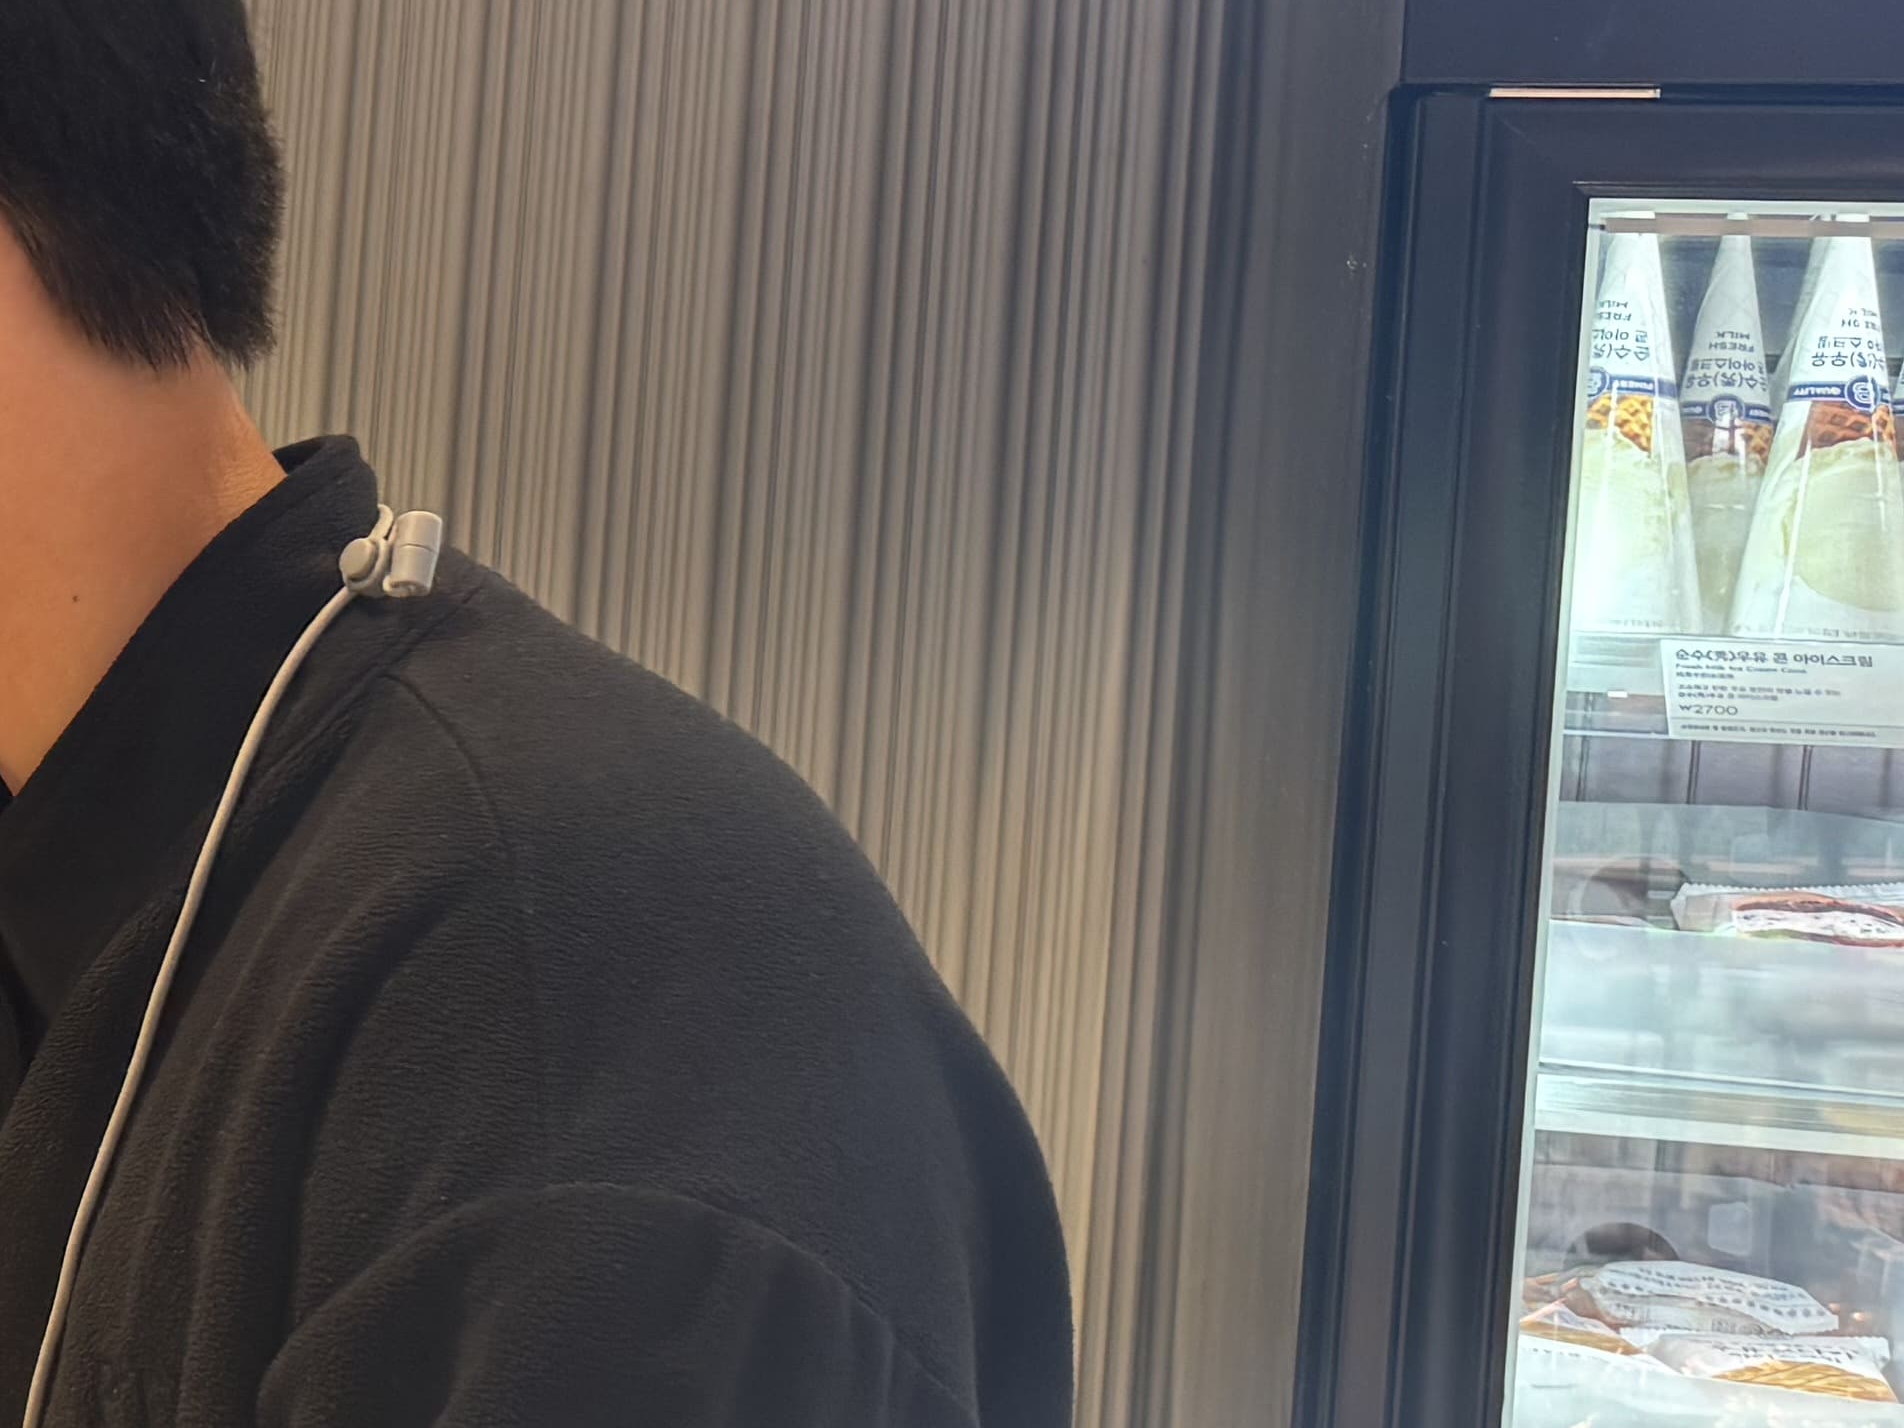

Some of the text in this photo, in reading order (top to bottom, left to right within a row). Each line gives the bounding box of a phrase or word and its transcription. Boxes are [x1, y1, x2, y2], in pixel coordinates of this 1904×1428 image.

[1716, 331, 1750, 341] MILK
[1708, 341, 1755, 354] FRESH
[1792, 652, 1873, 668] 아이스크림
